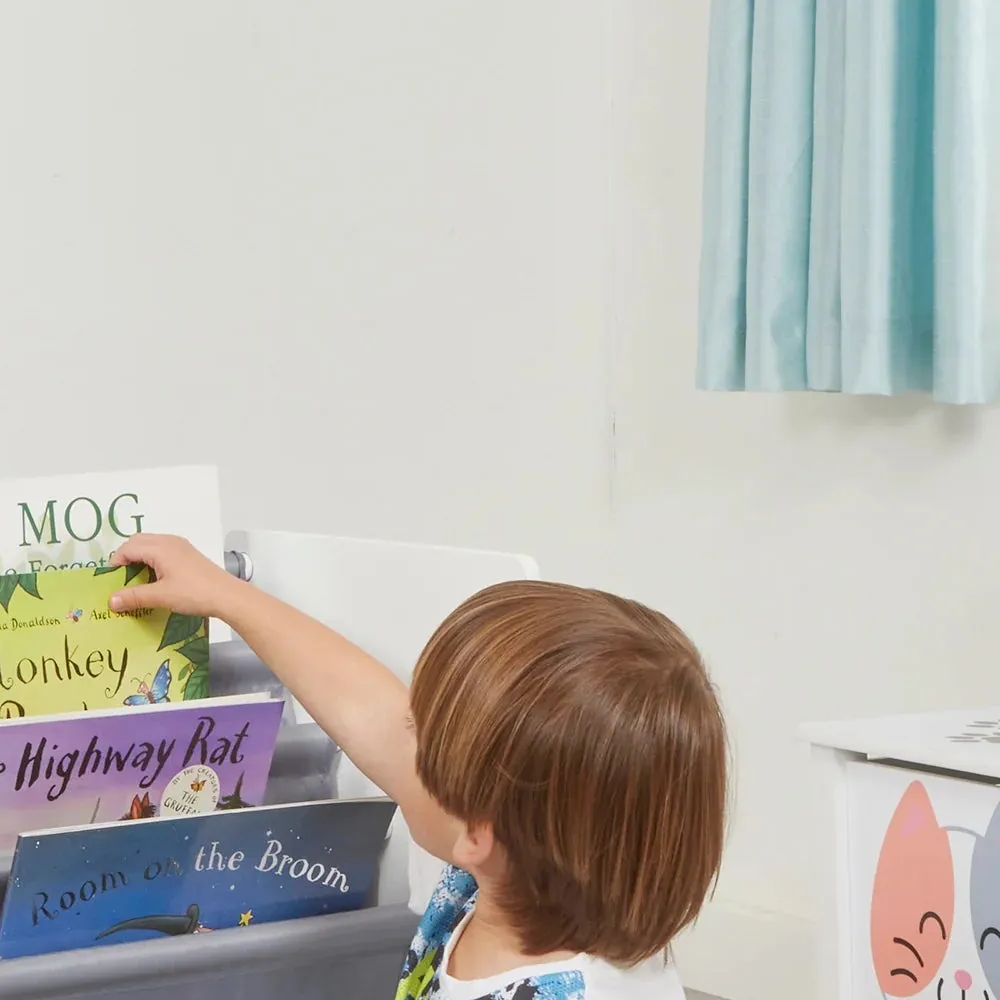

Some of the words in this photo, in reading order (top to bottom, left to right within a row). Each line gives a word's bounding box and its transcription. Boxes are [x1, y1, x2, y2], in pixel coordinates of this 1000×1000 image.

[17, 493, 145, 547] MOG
[11, 616, 61, 631] Donaldson
[89, 609, 111, 620] Axel
[14, 735, 175, 801] Highway
[183, 716, 250, 767] Rat
[181, 790, 199, 804] THE
[31, 871, 127, 927] Room
[143, 857, 183, 882] on
[195, 841, 245, 872] the
[255, 839, 350, 894] Broom
